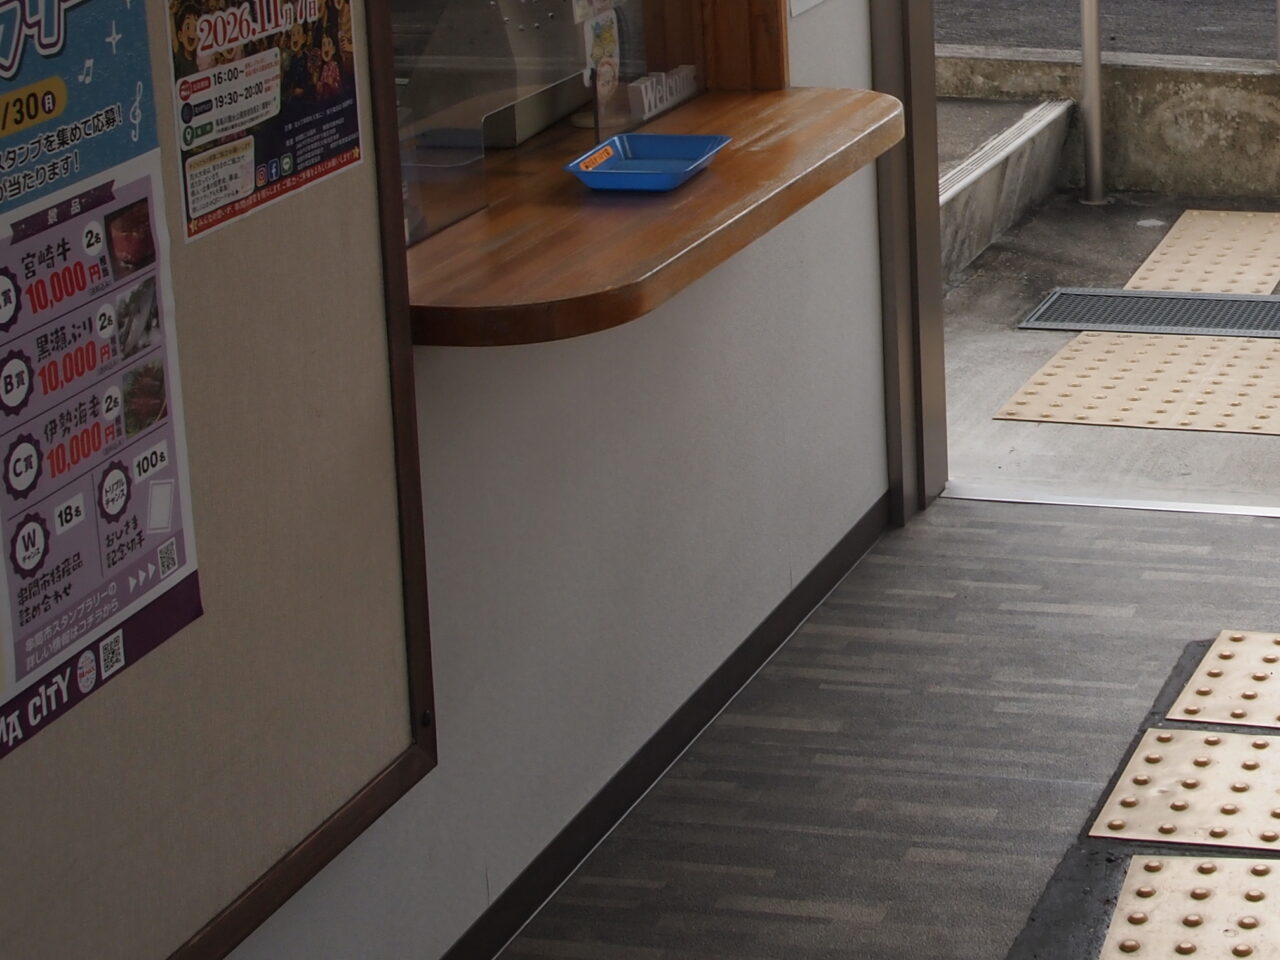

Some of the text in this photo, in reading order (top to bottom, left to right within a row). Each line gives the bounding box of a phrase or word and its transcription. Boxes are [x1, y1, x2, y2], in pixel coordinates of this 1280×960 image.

[640, 70, 697, 119] Welcom
[21, 238, 71, 280] 宮崎牛
[37, 317, 93, 363] 黒瀬ぶり
[4, 370, 25, 395] B賞
[44, 394, 101, 444] 伊勢海老
[13, 454, 34, 478] C賞
[136, 450, 166, 477] 100名
[104, 479, 125, 498] トリプル
[105, 489, 126, 510] チャンス
[58, 505, 82, 528] 18名
[22, 528, 37, 551] W
[107, 530, 145, 568] 記念切手
[18, 552, 84, 606] 串間市特産品
[19, 584, 72, 627] 詰め合わせ
